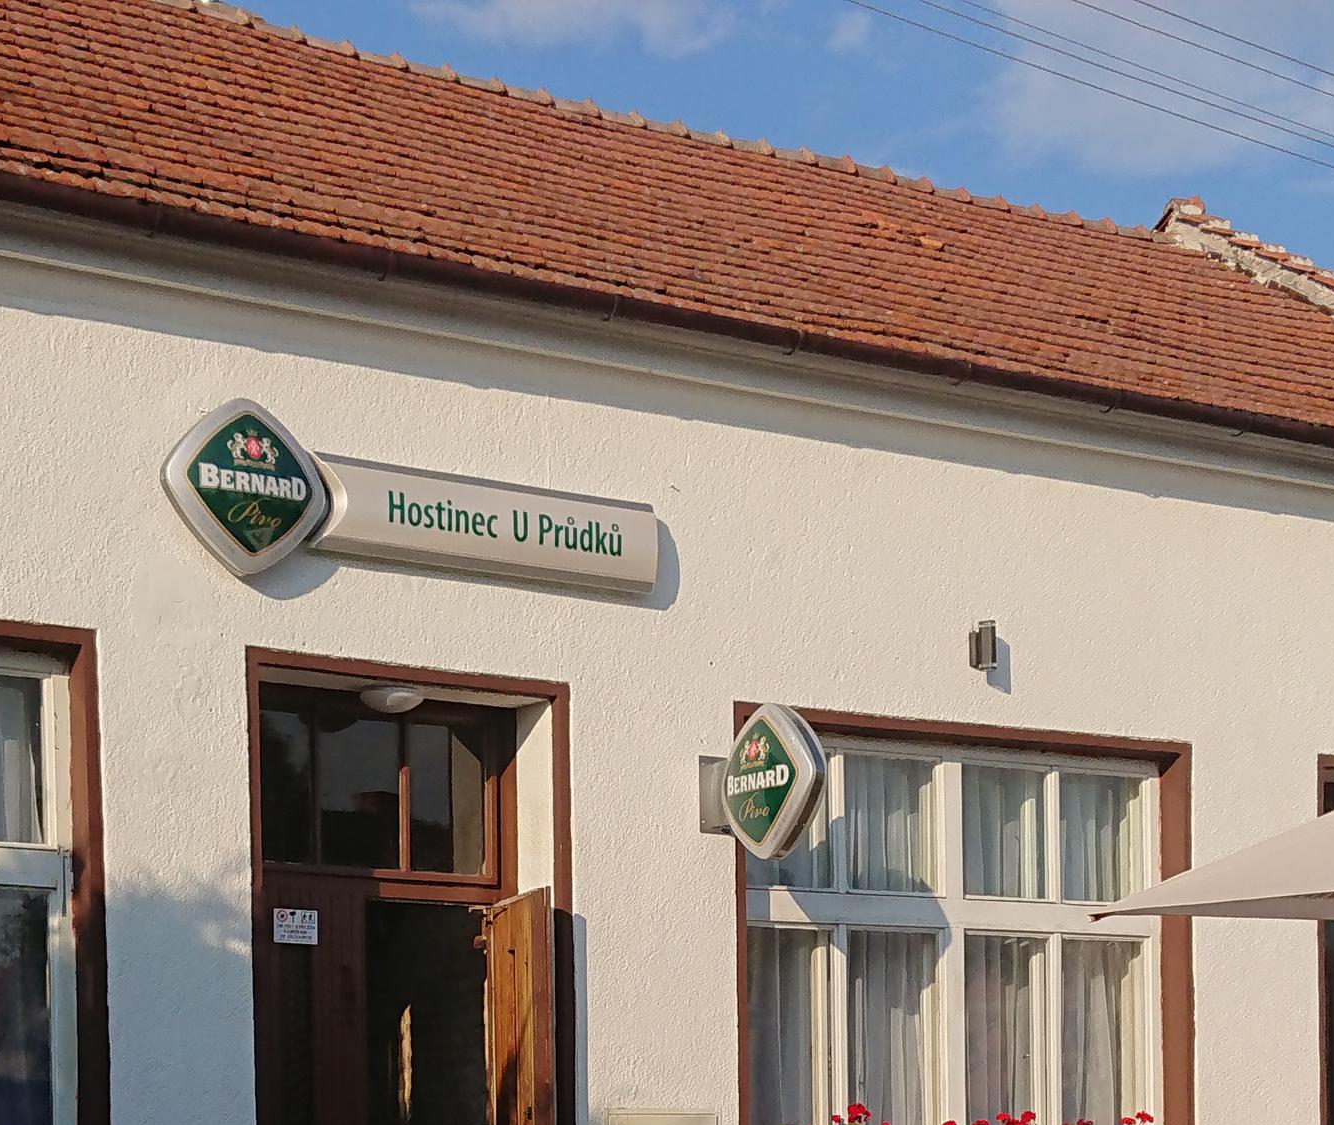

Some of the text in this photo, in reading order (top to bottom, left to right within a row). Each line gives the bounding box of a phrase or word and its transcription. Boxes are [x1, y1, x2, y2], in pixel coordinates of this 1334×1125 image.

[198, 462, 307, 501] BERNARD
[388, 490, 622, 556] Hostinec U Průdků
[727, 764, 789, 798] BERNARD
